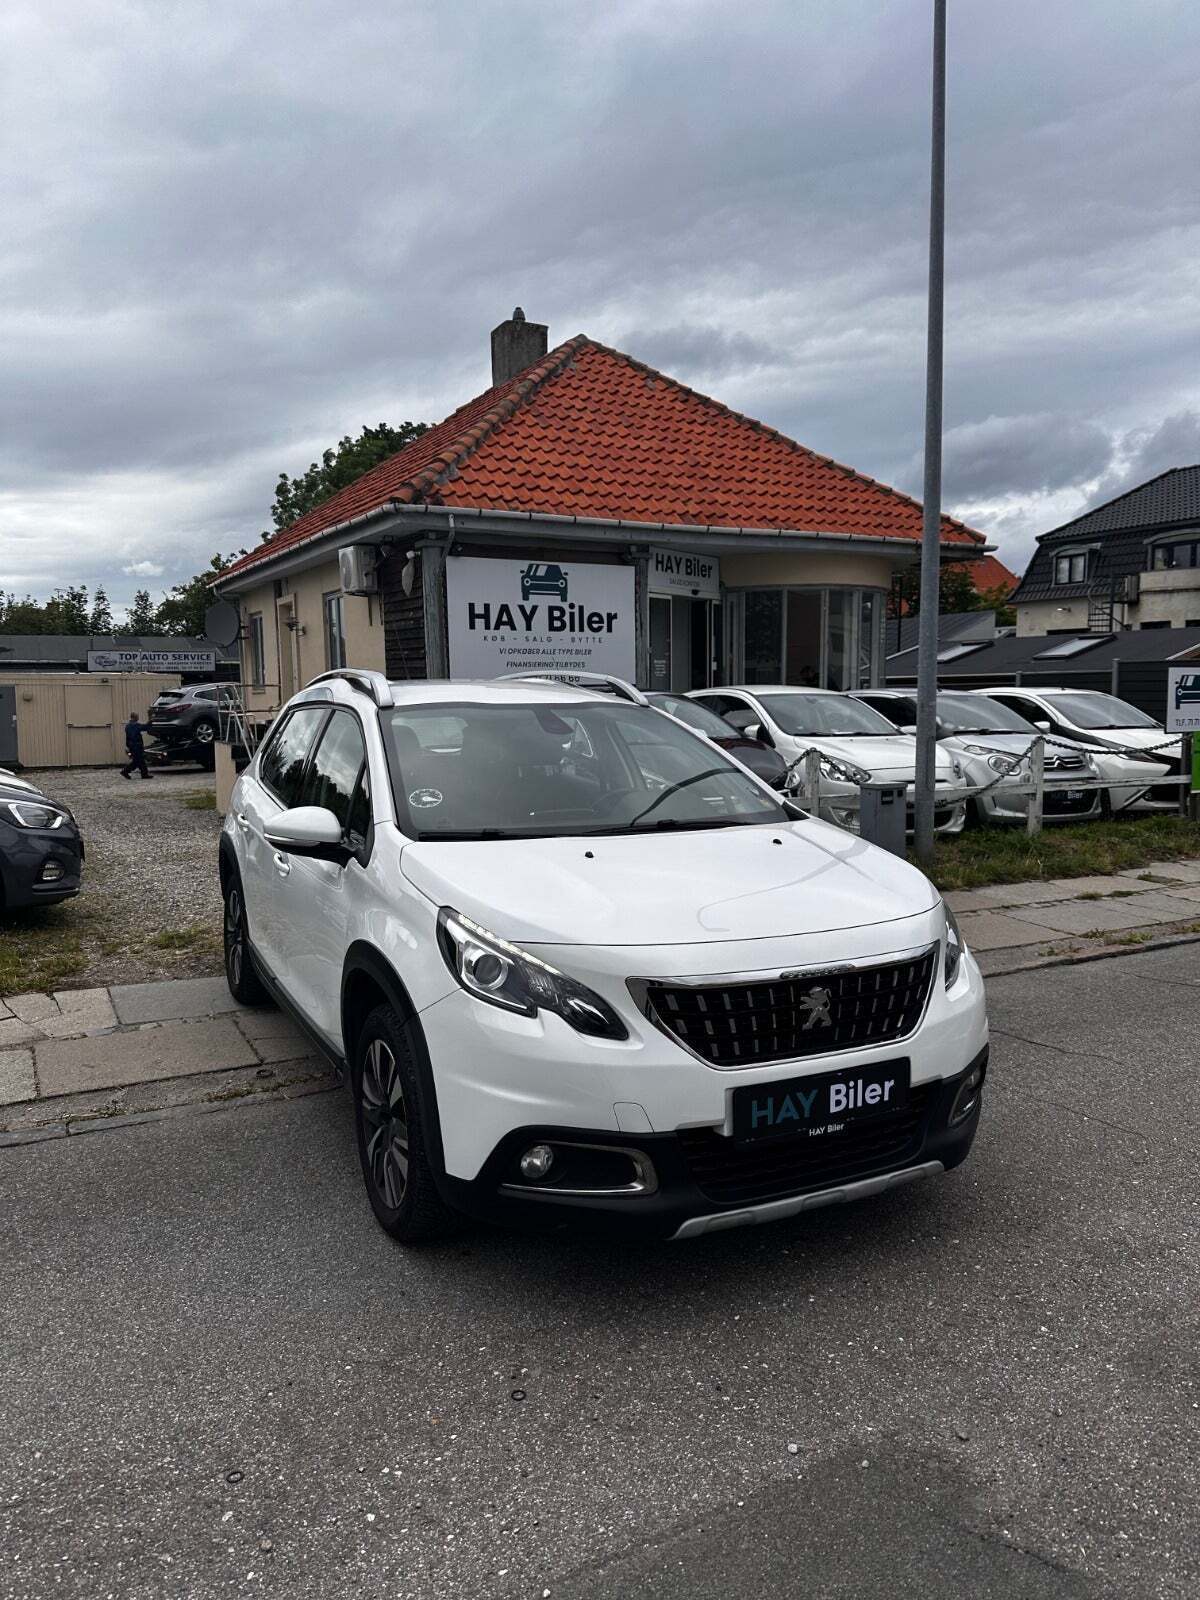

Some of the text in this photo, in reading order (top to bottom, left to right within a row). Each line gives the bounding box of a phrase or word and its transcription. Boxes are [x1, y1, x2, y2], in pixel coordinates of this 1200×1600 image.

[655, 552, 713, 578] HAY Biler
[468, 602, 618, 633] HAY Biler
[119, 653, 138, 661] TOP
[499, 647, 507, 655] VI
[752, 1079, 895, 1129] HAY Biler
[809, 1124, 844, 1136] HAY Biler
